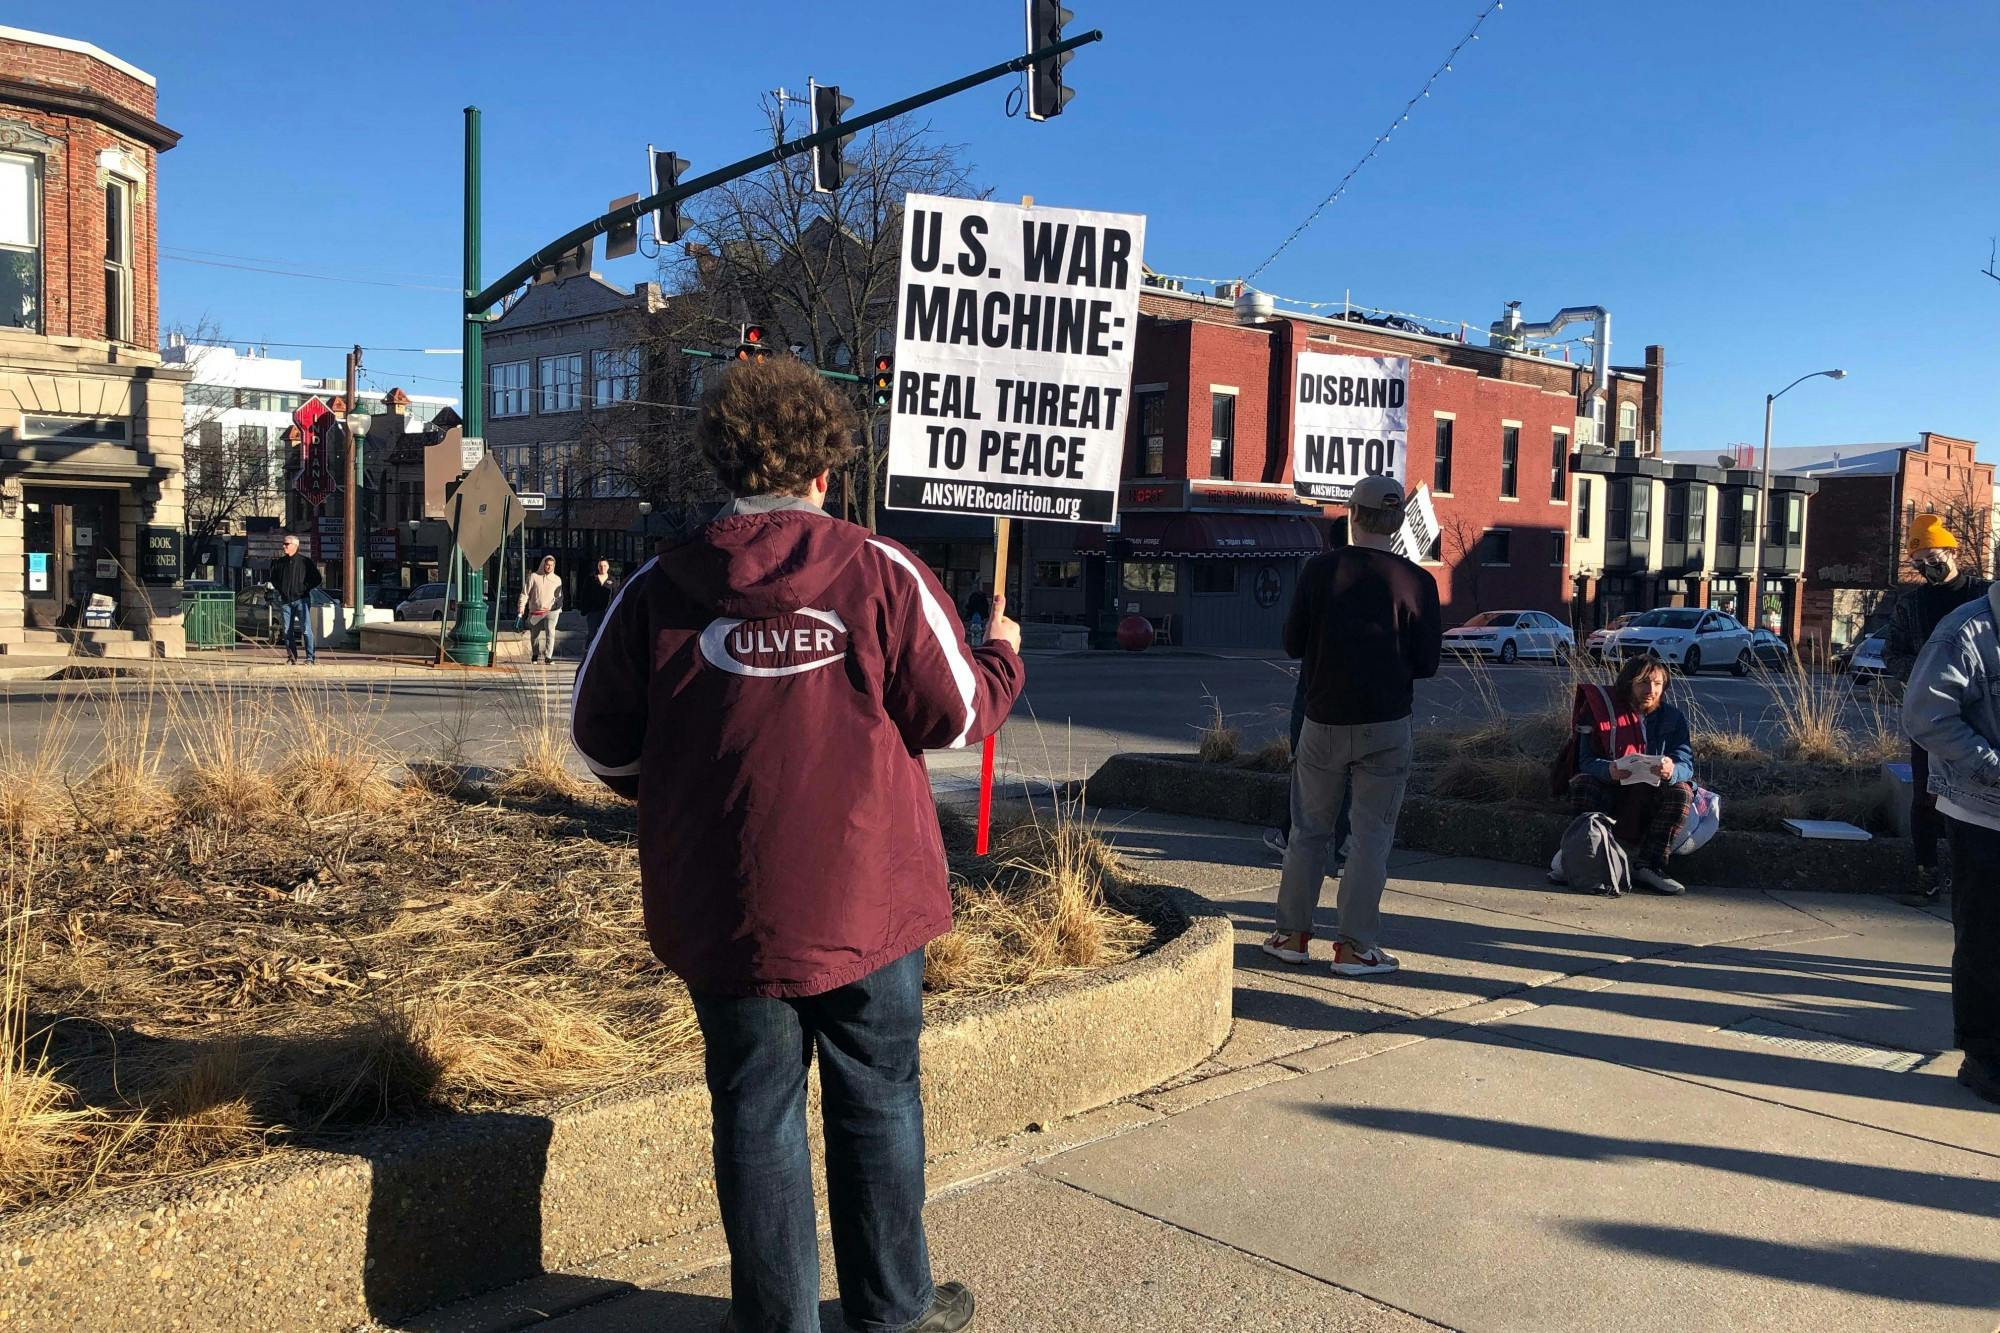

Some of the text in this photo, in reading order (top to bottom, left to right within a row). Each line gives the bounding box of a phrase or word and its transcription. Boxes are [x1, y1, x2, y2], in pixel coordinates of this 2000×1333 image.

[910, 209, 1132, 290] U.S. WAR
[904, 283, 1125, 357] MACHINE:
[897, 370, 1122, 430] REAL THREAT
[1299, 372, 1405, 408] DISBAND
[312, 413, 321, 490] INDIANA
[926, 425, 1086, 480] TO PEACE
[1304, 434, 1396, 477] NATO!
[921, 482, 1082, 520] ANSWERcoalition.org
[1259, 491, 1288, 505] HORSE
[149, 537, 172, 549] BOOK
[1404, 498, 1431, 556] DISBAND
[144, 554, 177, 566] CORNER
